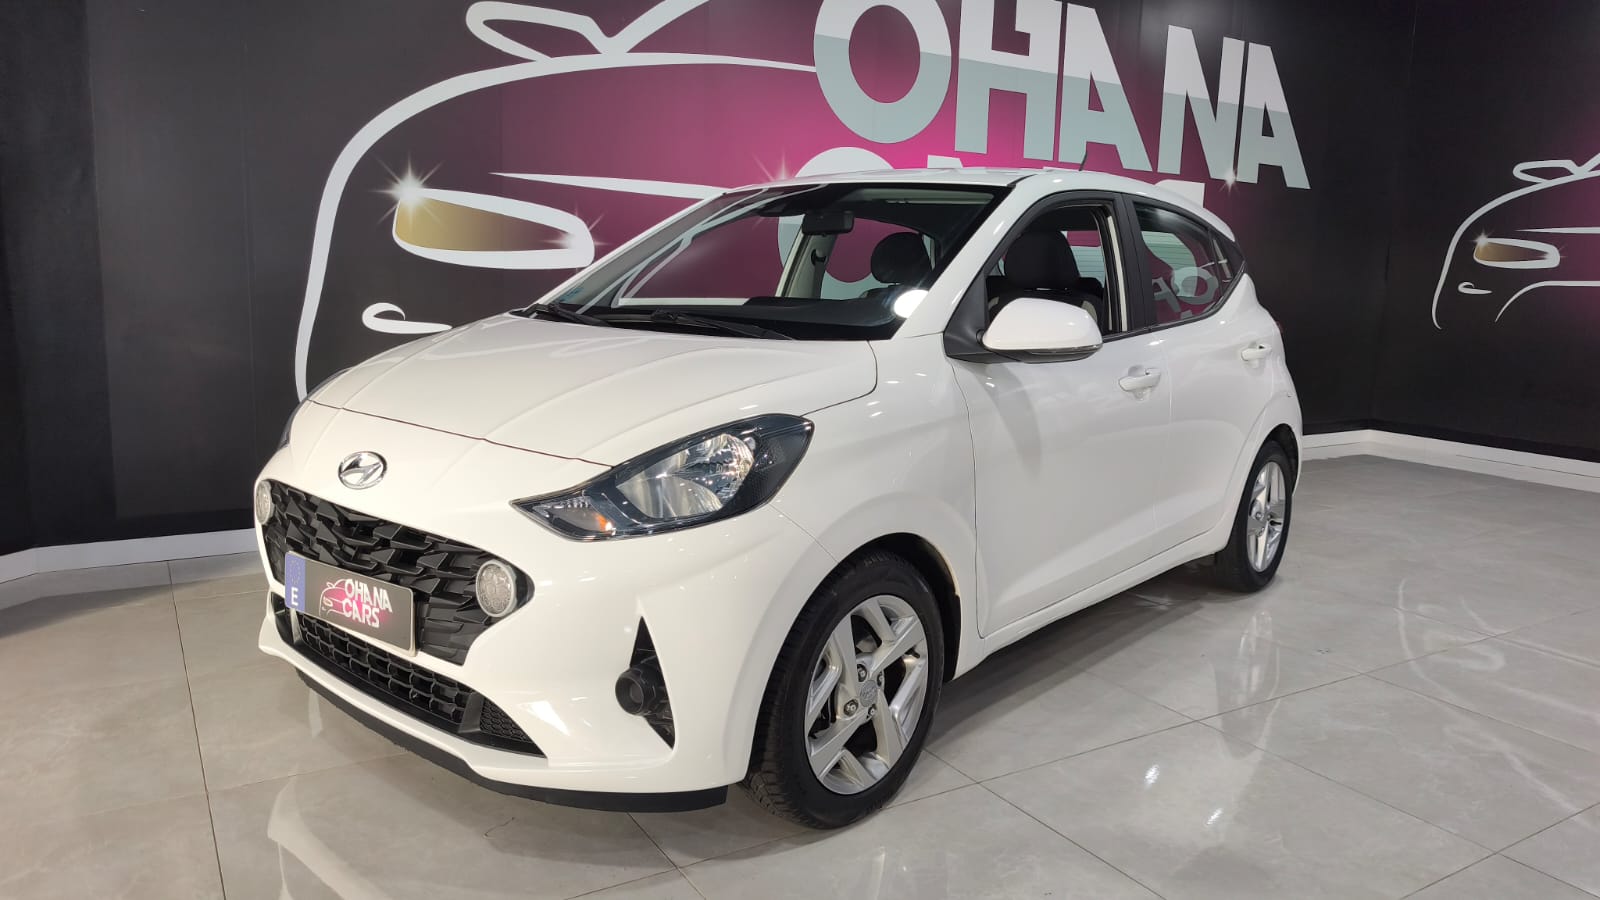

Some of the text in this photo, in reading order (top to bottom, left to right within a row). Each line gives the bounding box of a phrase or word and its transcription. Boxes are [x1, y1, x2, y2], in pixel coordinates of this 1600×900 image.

[813, 0, 1311, 190] OHANA
[291, 587, 299, 606] E
[344, 578, 393, 612] OHANA
[342, 598, 380, 628] CARS
